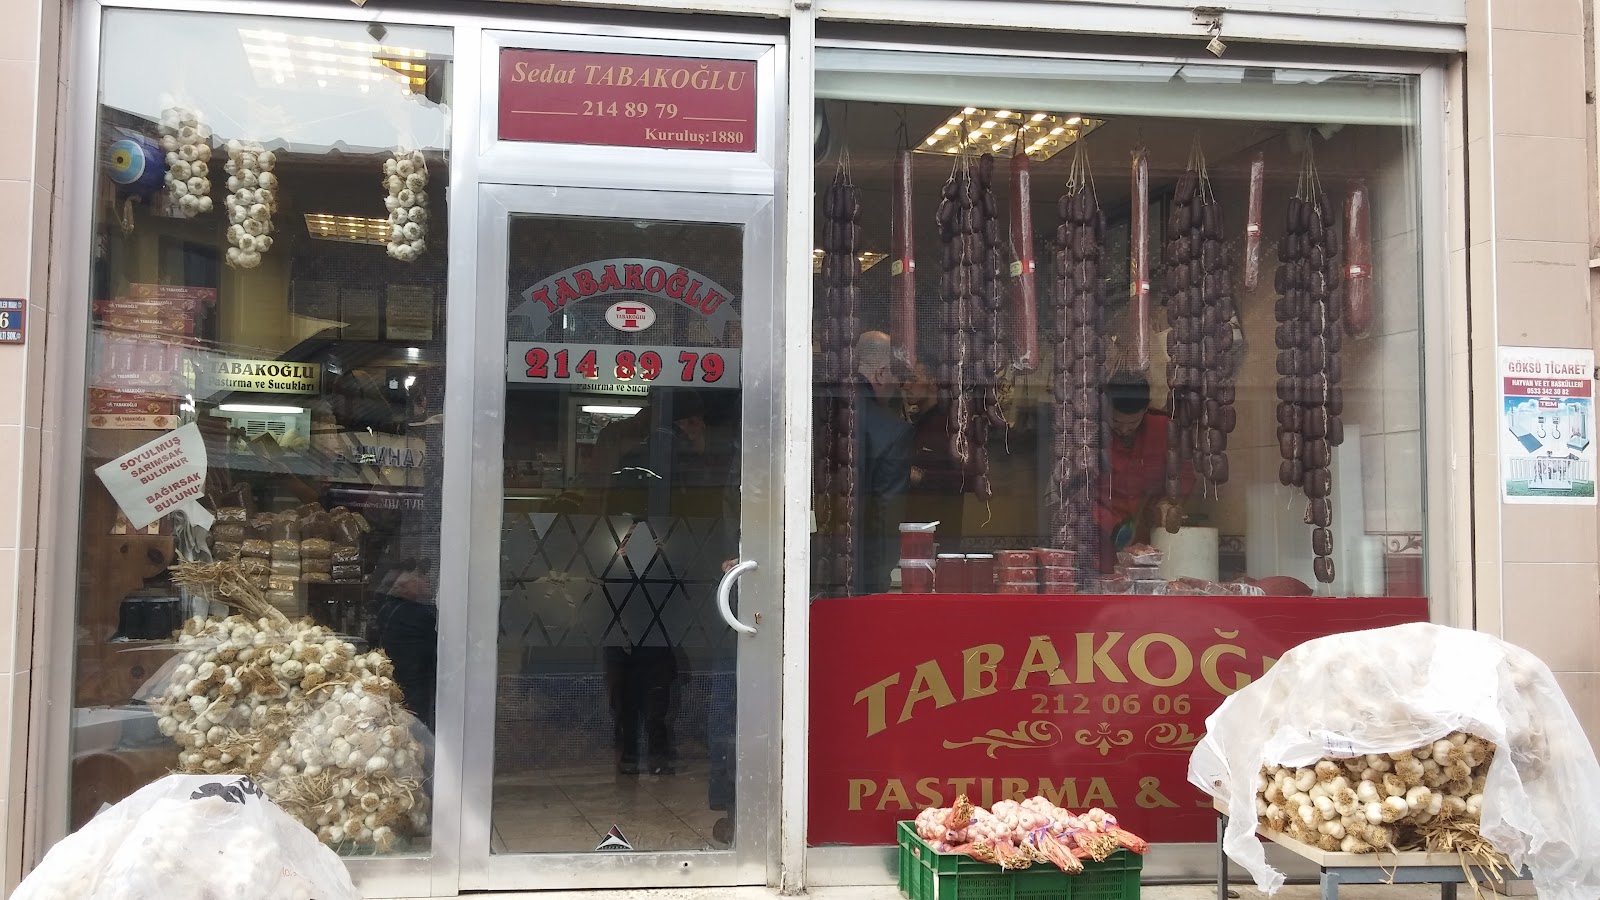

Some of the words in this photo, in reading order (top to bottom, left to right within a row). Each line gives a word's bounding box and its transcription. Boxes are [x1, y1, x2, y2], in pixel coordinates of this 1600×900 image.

[511, 61, 577, 84] Sedat
[584, 63, 747, 91] TABAKOĞLU
[582, 101, 618, 118] 214
[624, 101, 649, 119] 89
[655, 103, 678, 119] 79
[645, 128, 744, 146] Kuruluş:1880
[531, 263, 727, 316] TABAKOĞLU
[0, 311, 9, 329] 6
[209, 361, 315, 379] TABAKOĞLU
[525, 347, 599, 380] 214
[614, 350, 663, 381] 89
[678, 351, 725, 383] 79
[1545, 361, 1587, 375] TİCARET
[255, 380, 265, 389] ve
[268, 379, 315, 391] Sucukları
[120, 436, 181, 471] SOYULMUŞ
[131, 447, 184, 478] SARIMSAK
[140, 456, 189, 485] BULUNUR
[145, 472, 201, 505] BAĞIRSAK
[853, 628, 1279, 738] TABAKOĞ
[1031, 694, 1090, 715] 212
[1102, 694, 1142, 714] 06
[1152, 694, 1192, 714] 06
[847, 776, 1119, 811] PASTIRMA
[1135, 776, 1181, 809] &
